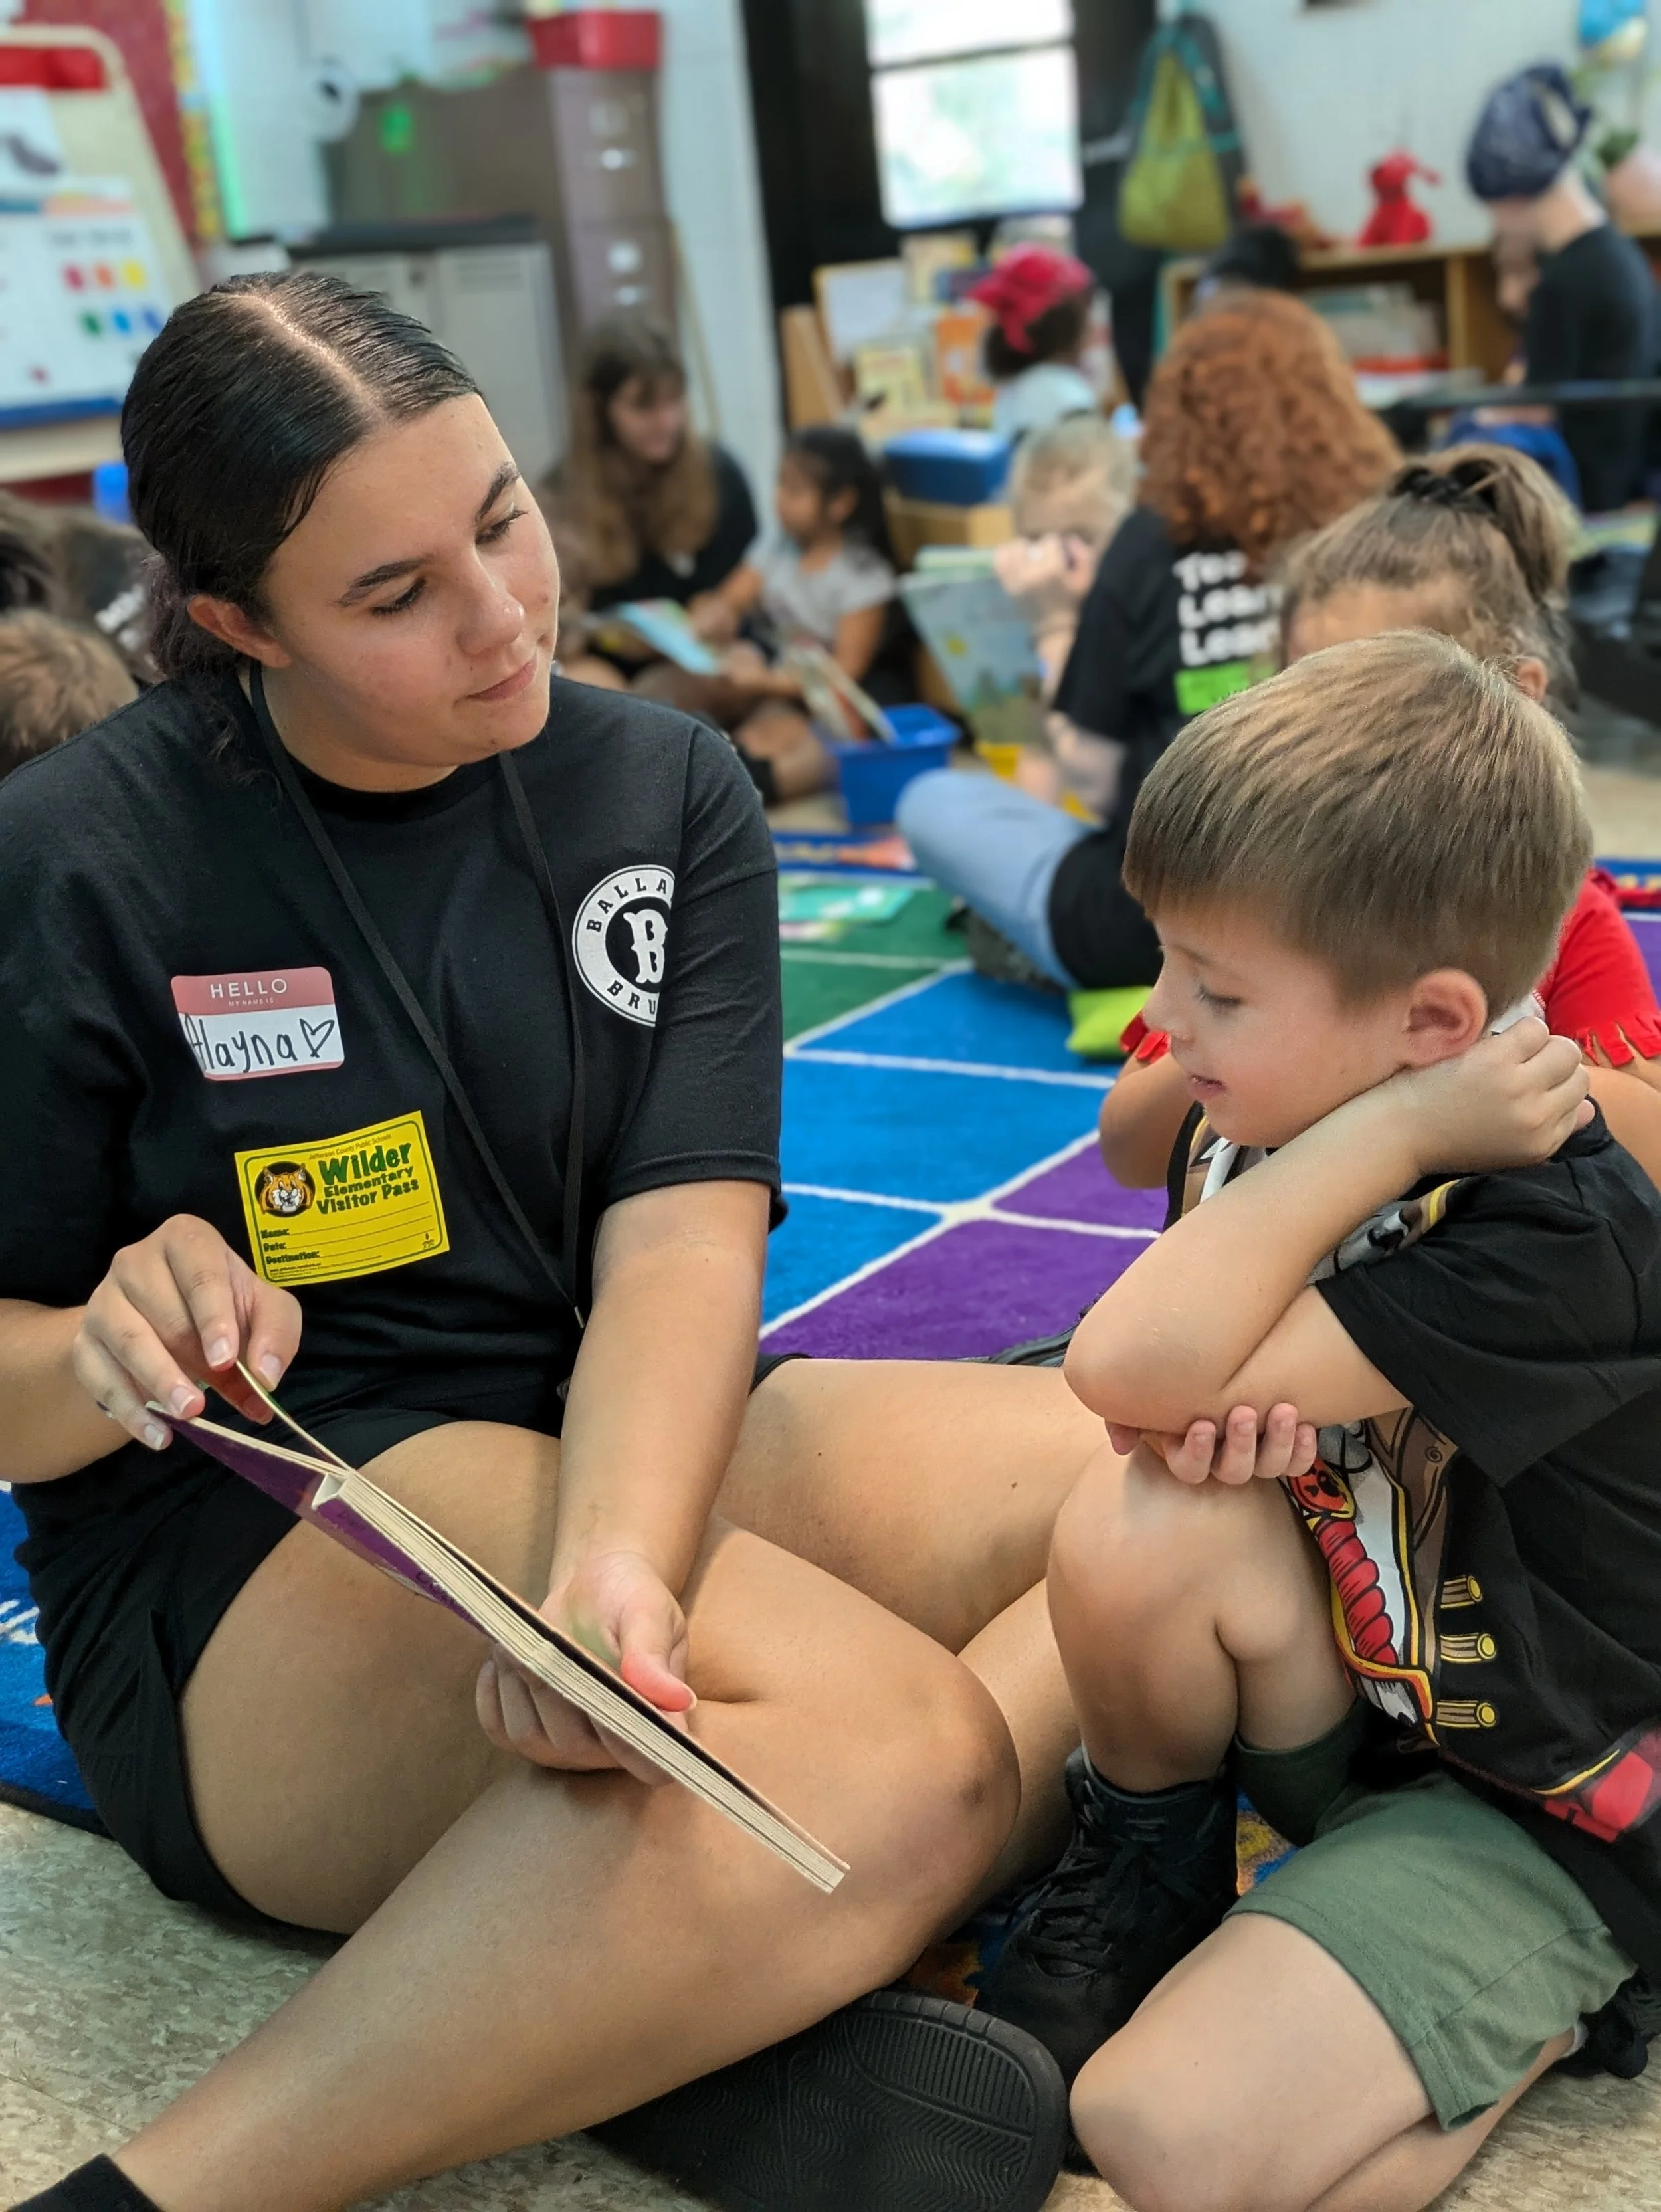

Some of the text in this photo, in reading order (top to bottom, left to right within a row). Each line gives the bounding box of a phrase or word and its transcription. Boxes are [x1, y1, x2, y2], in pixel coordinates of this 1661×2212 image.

[586, 878, 667, 933] BALLA
[210, 978, 287, 999] HELLO
[607, 979, 656, 1015] BRU
[308, 1134, 392, 1160] Jefferson County Public Schools
[318, 1142, 412, 1185] Wilder
[316, 1179, 419, 1215] Visitor Pass
[324, 1166, 414, 1198] Elementary
